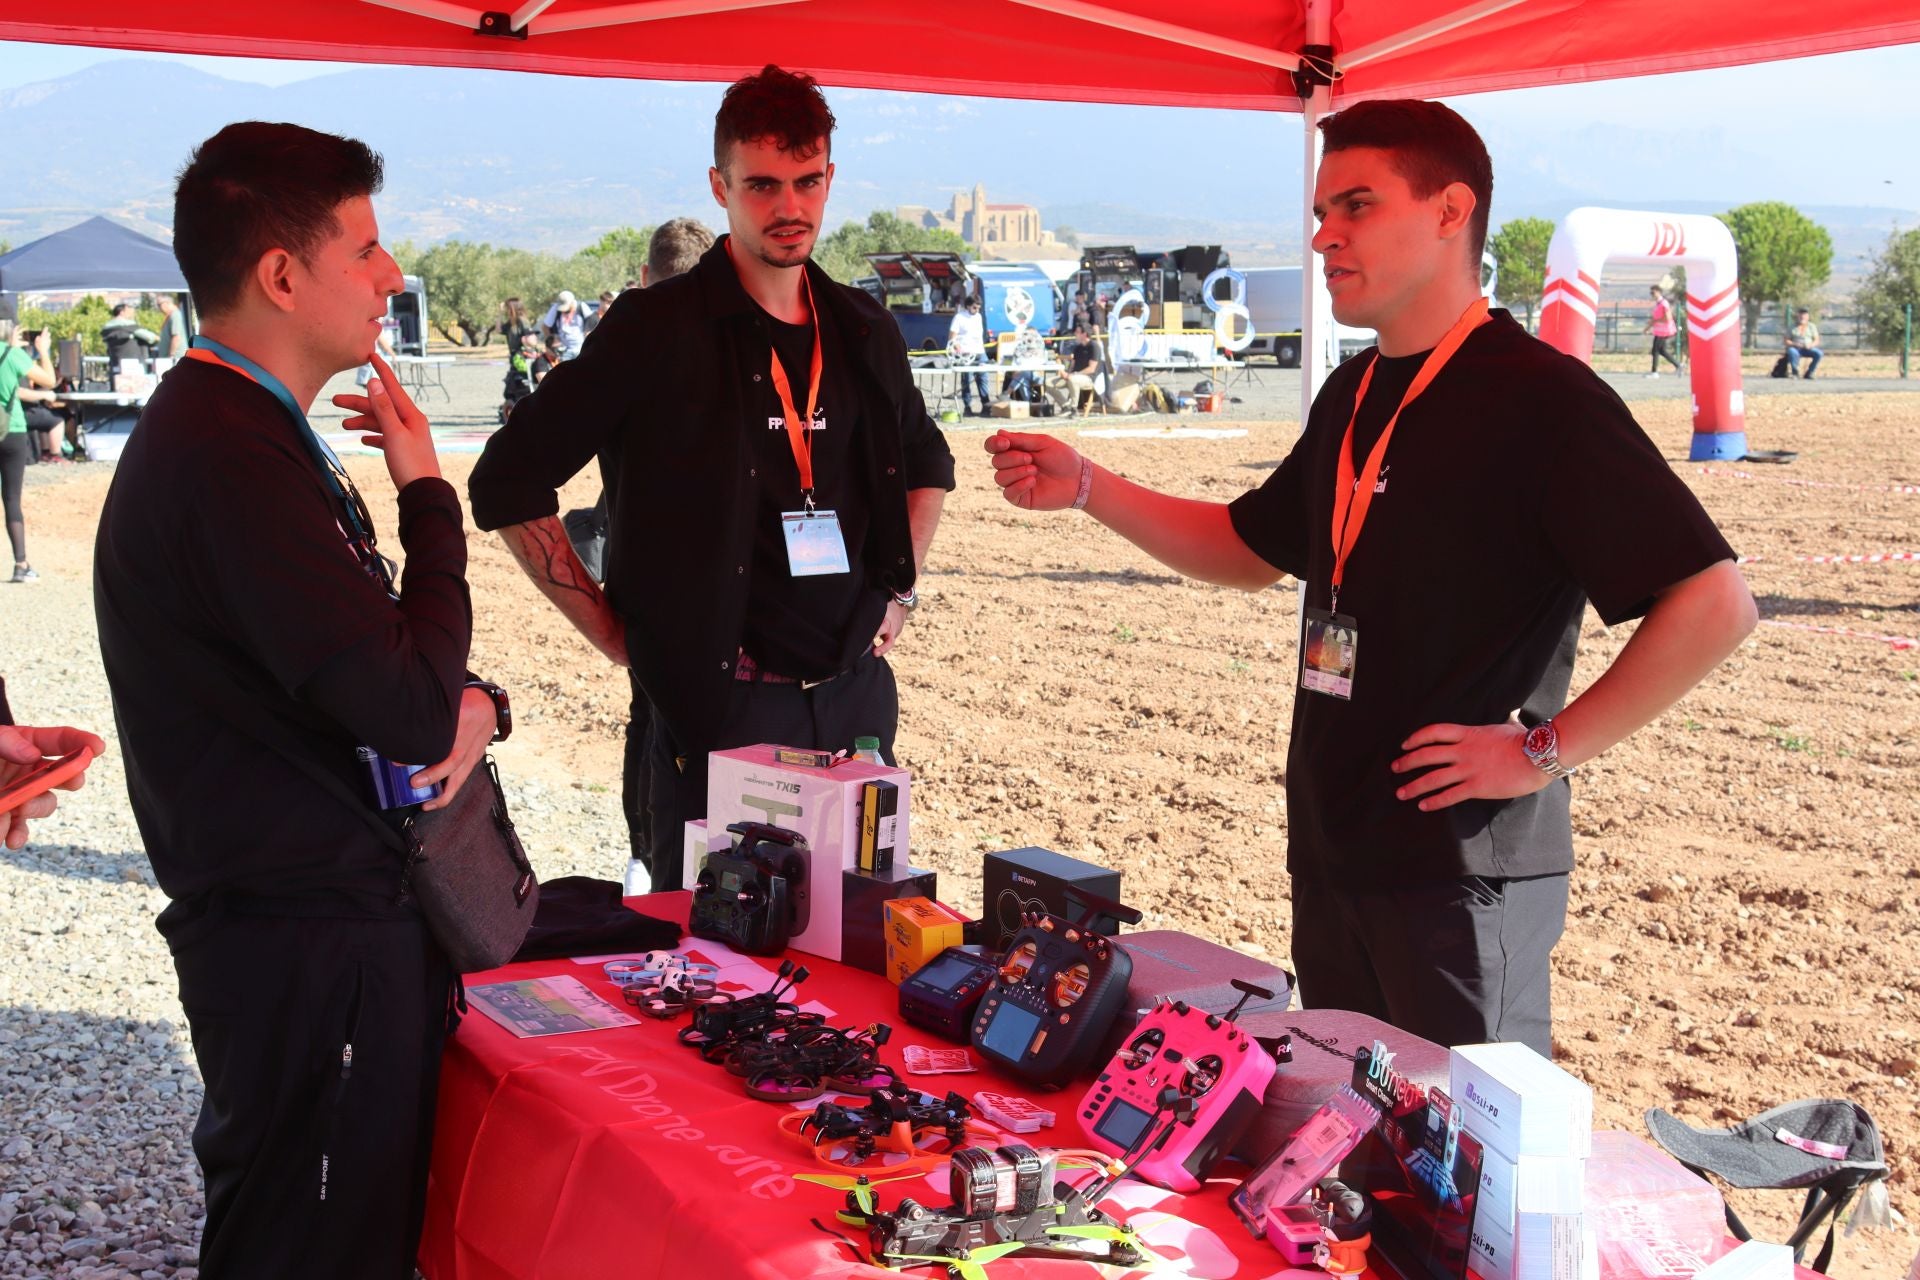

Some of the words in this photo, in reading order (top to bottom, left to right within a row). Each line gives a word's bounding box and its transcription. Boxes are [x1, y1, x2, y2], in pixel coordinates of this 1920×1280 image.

[1648, 222, 1687, 256] IDL
[600, 1072, 706, 1141] Drone
[321, 1153, 329, 1183] SPORT
